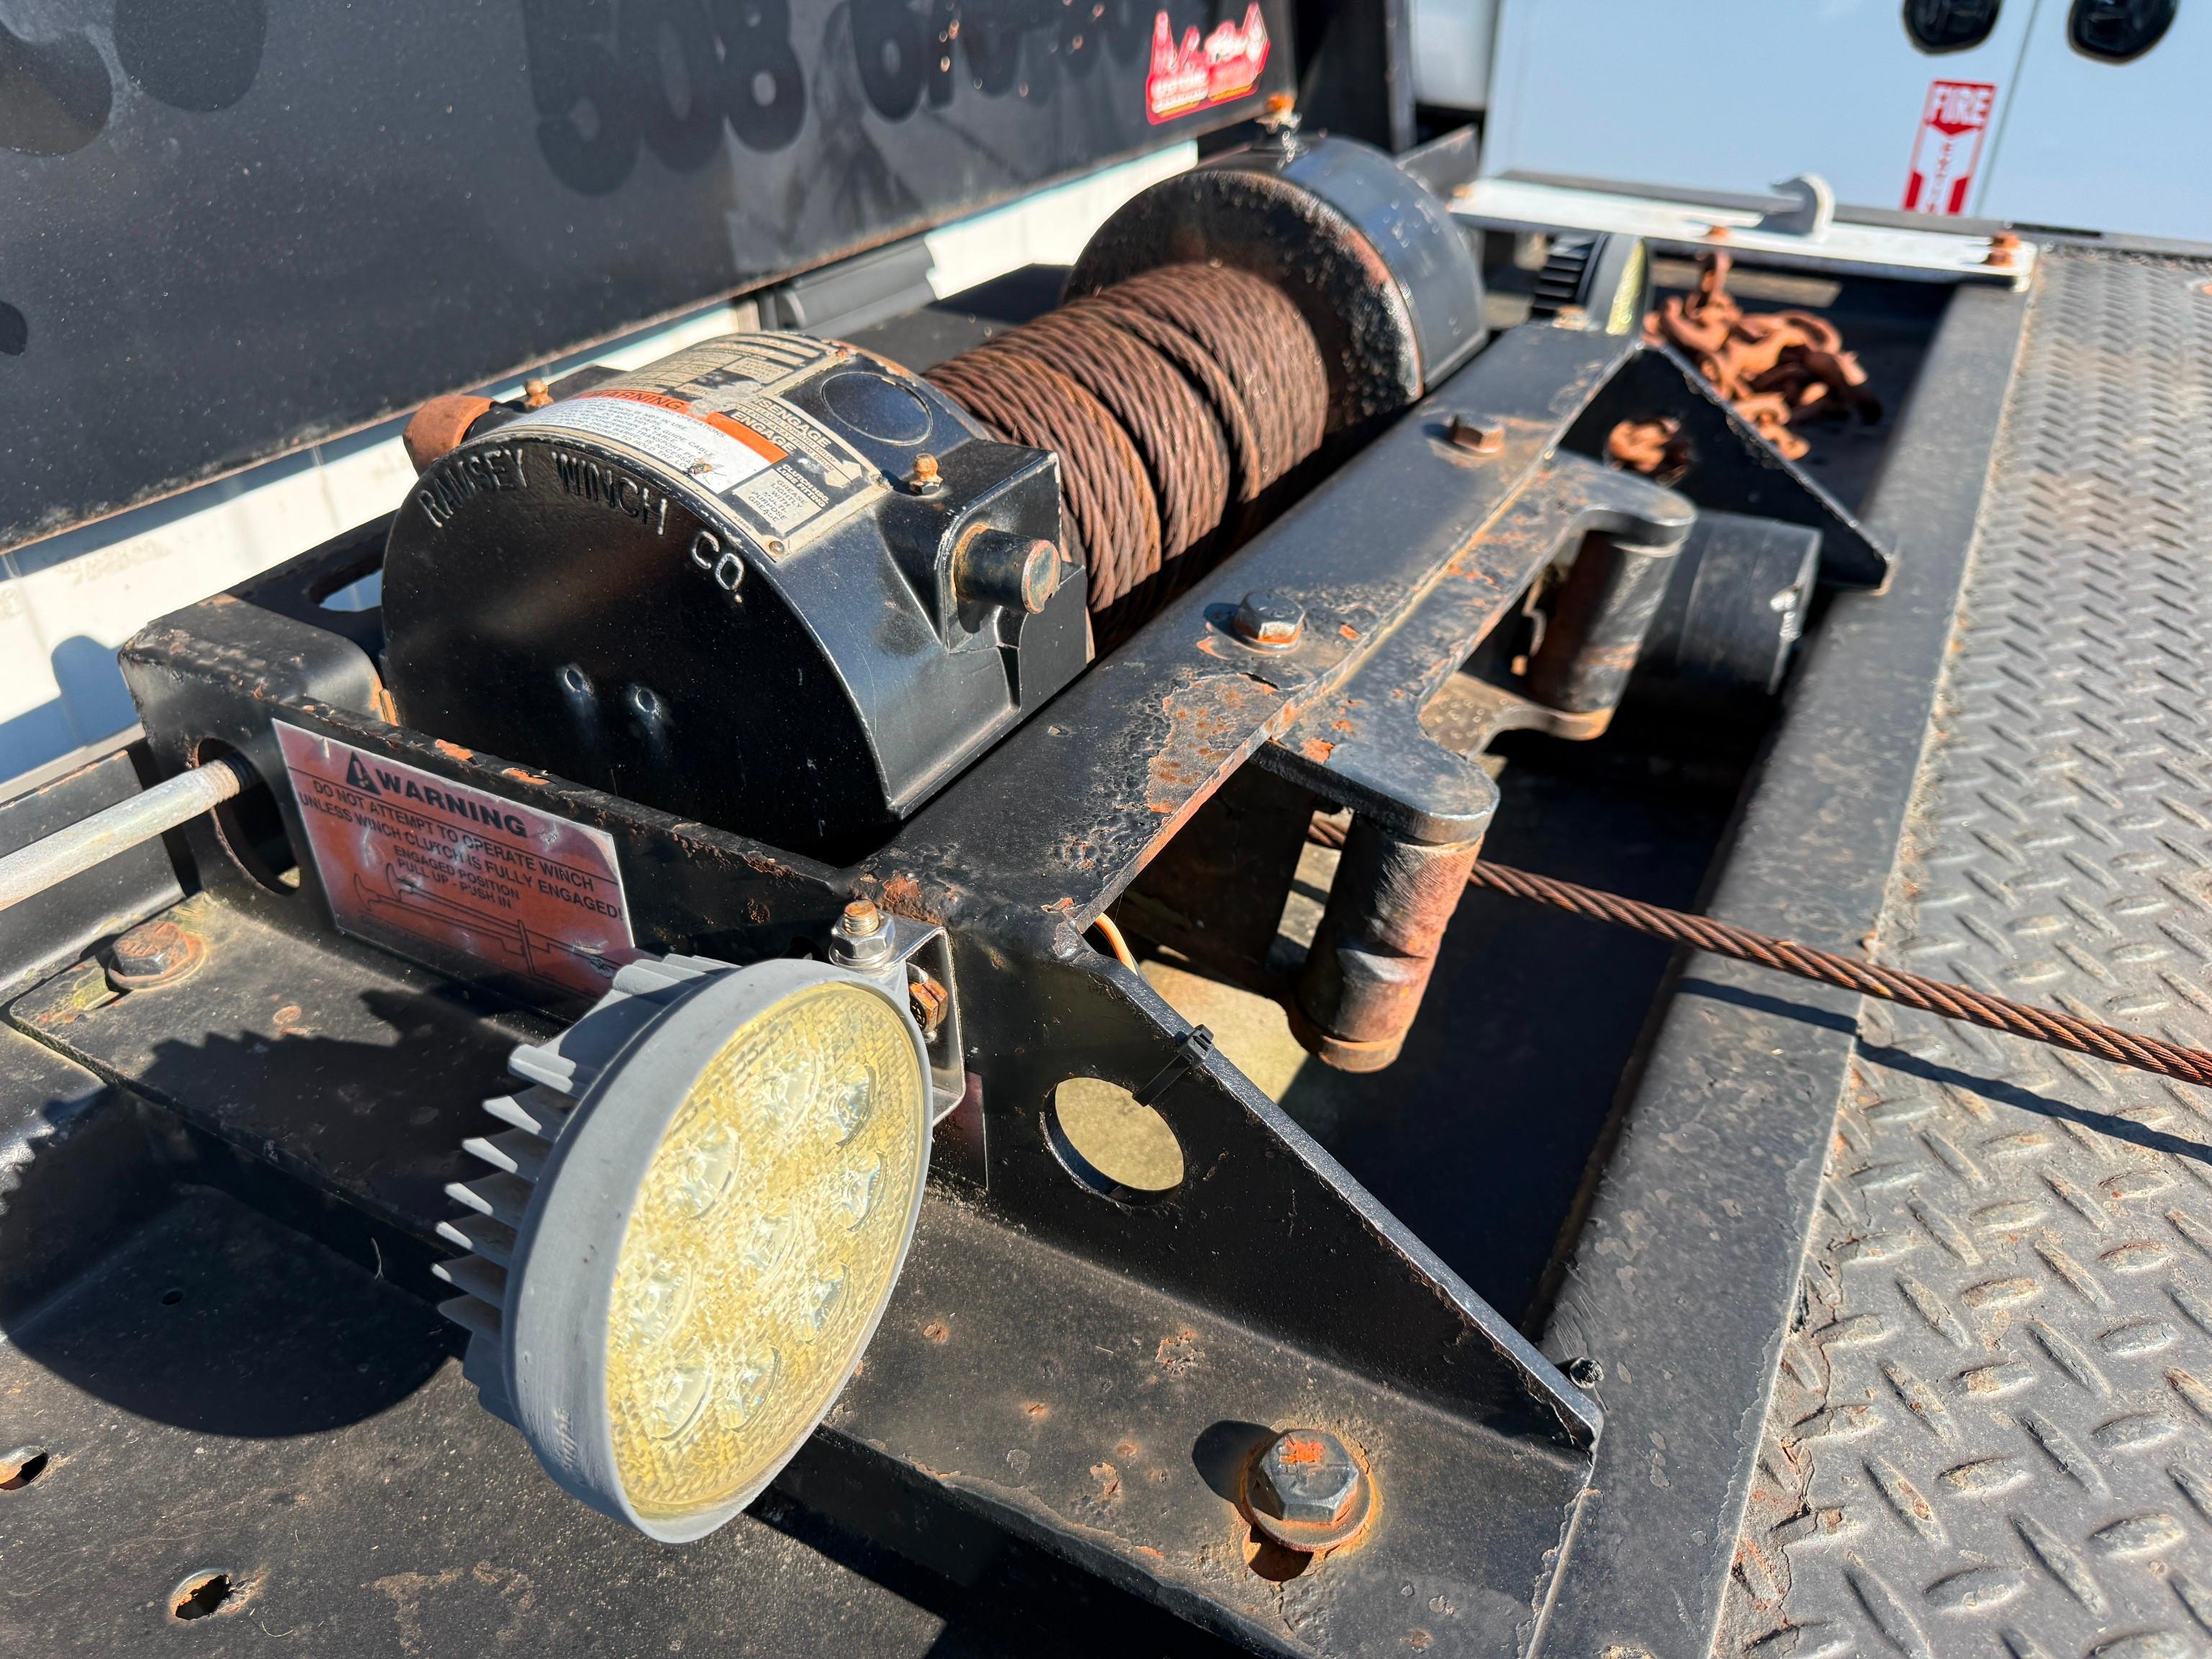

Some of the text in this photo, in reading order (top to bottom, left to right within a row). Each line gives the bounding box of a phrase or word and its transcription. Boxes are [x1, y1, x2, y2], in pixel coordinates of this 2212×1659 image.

[1926, 87, 1992, 122] FIRE
[596, 390, 685, 410] WARNING
[634, 430, 683, 452] TRANSPORT
[660, 429, 688, 442] GUIDE
[731, 412, 798, 453] ENGAGE
[755, 399, 832, 448] ISENGAGE
[631, 439, 657, 451] HOLD
[655, 450, 674, 460] THE
[769, 422, 791, 438] AWAY
[792, 437, 813, 454] FROM
[813, 453, 835, 472] DRUM
[814, 446, 836, 463] DRUM
[417, 447, 528, 528] RAMSEY
[551, 451, 668, 535] WINCH
[771, 483, 803, 508] LIGHTLY
[771, 489, 791, 507] WITH
[776, 466, 826, 507] LUBE FITTING
[777, 479, 806, 506] GREASE
[749, 496, 781, 522] GREASE
[751, 492, 788, 520] PURPOSE
[375, 769, 528, 838] WARNING
[313, 780, 595, 892] DO NOT ATTEMPT TO OPERATE WINCH
[299, 792, 624, 921] UNLESS WINCH CLUTCH IS FULLY ENGAGED!
[394, 845, 520, 900] ENGAGED POSITION
[397, 858, 430, 879] PULL
[433, 873, 448, 884] UP
[498, 896, 512, 908] IN
